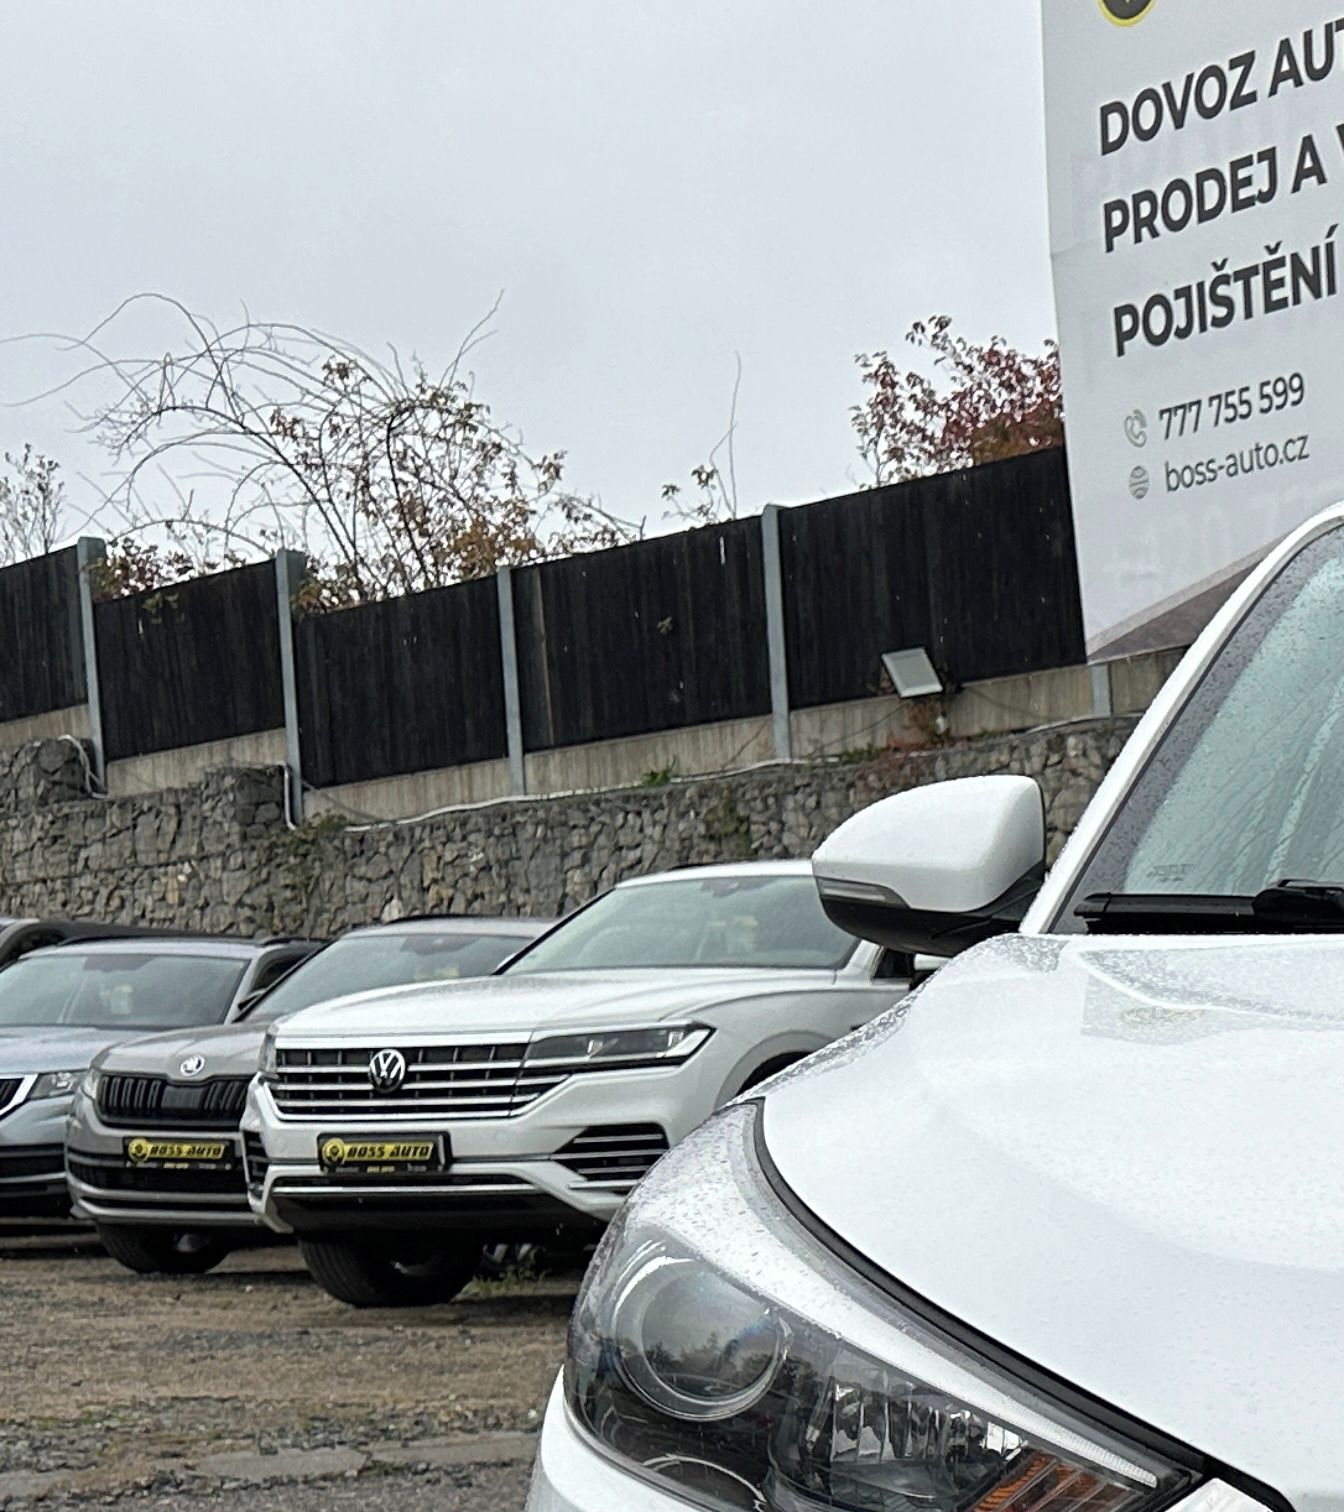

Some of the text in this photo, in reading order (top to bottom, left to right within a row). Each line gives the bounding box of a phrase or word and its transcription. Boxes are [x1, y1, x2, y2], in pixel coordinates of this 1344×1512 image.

[1100, 50, 1257, 156] DOVOZ
[1103, 146, 1277, 254] PRODEJ
[1291, 134, 1328, 194] A
[1113, 223, 1340, 358] POJIŠTĚNÍ
[1159, 372, 1305, 441] 777 755 599
[1164, 434, 1310, 493] boss-auto.cz
